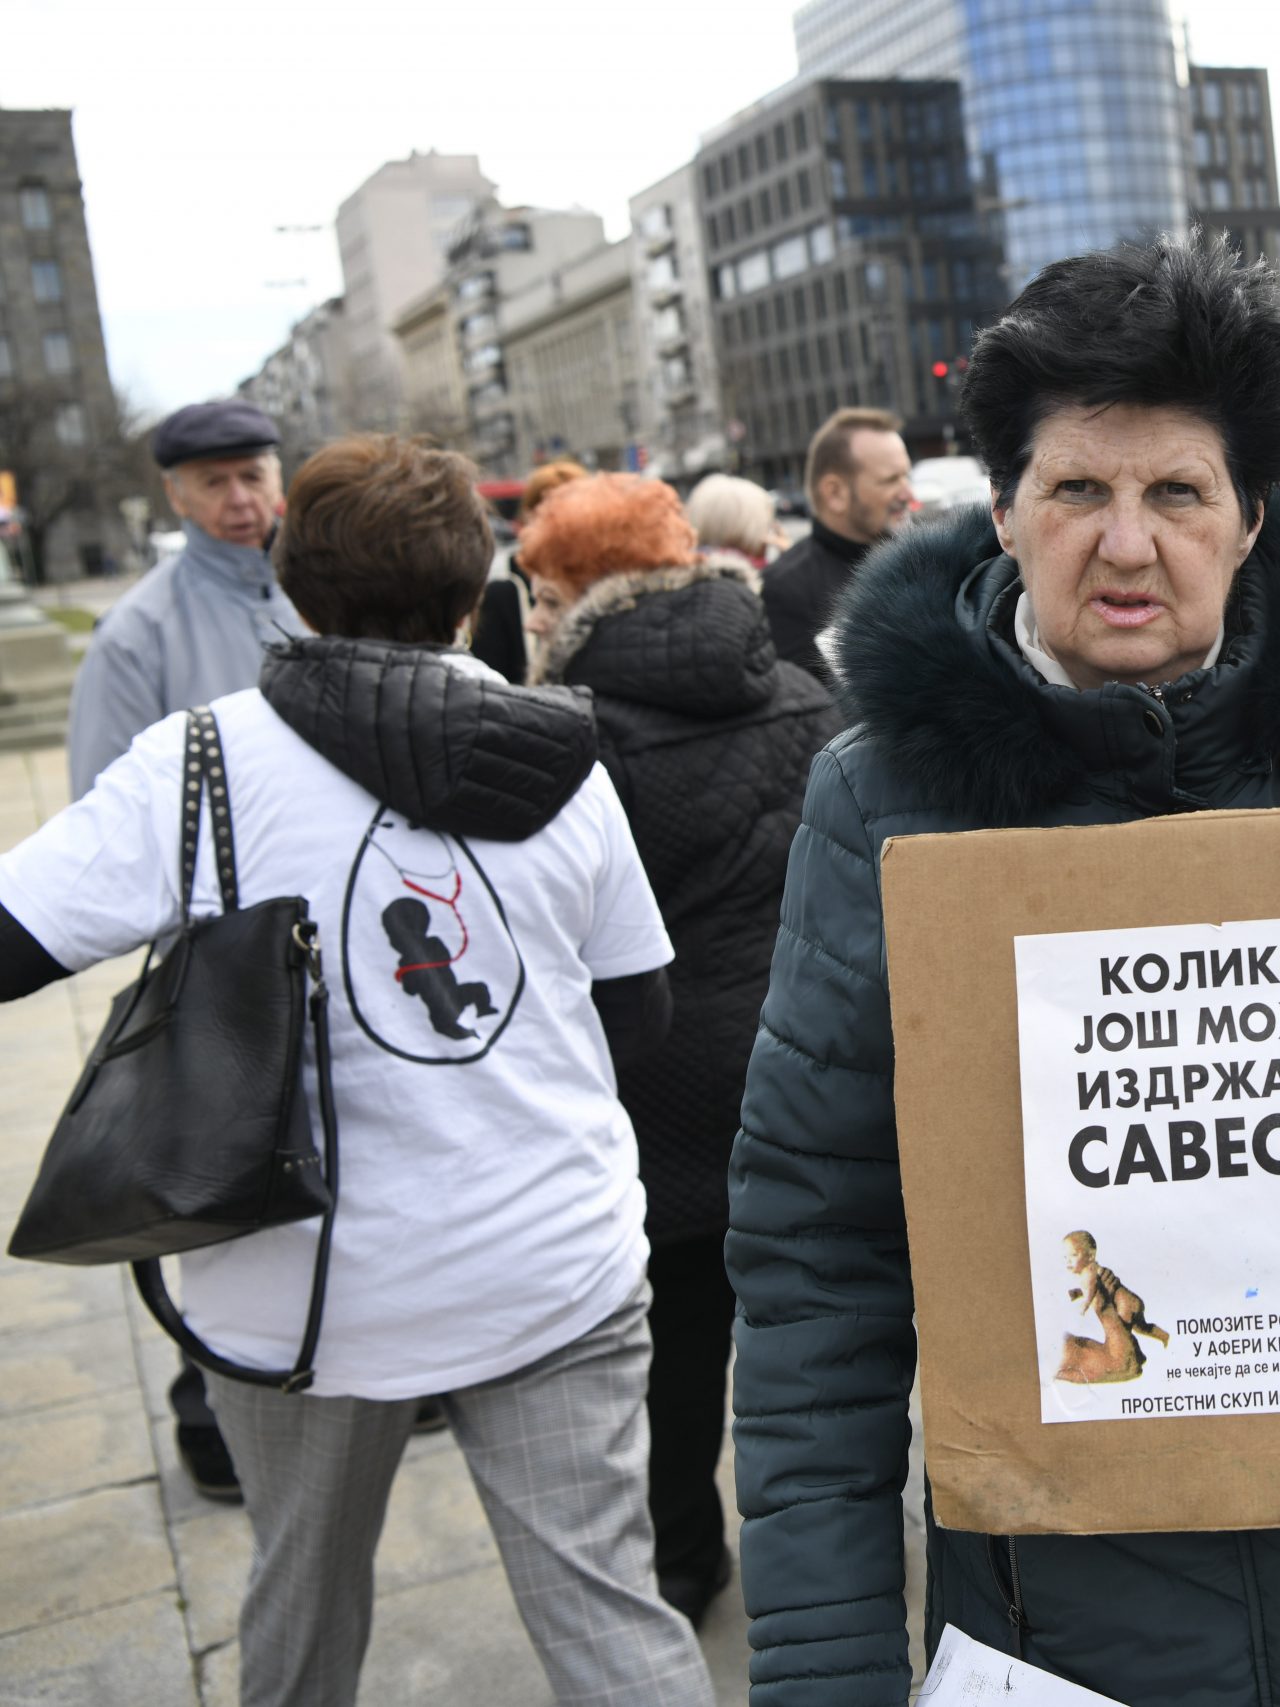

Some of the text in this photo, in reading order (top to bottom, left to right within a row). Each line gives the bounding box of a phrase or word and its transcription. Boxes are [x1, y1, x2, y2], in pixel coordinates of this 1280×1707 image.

[1074, 1009, 1178, 1054] ЈОШ
[1176, 1314, 1264, 1335] ПОМОЗИТЕ
[1193, 1341, 1203, 1357] У
[1208, 1338, 1262, 1356] АФЕРИ
[1166, 1368, 1181, 1379] не
[1185, 1364, 1231, 1379] чекајте
[1235, 1364, 1251, 1377] да
[1254, 1362, 1268, 1373] се
[1272, 1362, 1280, 1372] и
[1121, 1394, 1216, 1415] ПРОТЕСТНИ
[1220, 1391, 1264, 1408] СКУП
